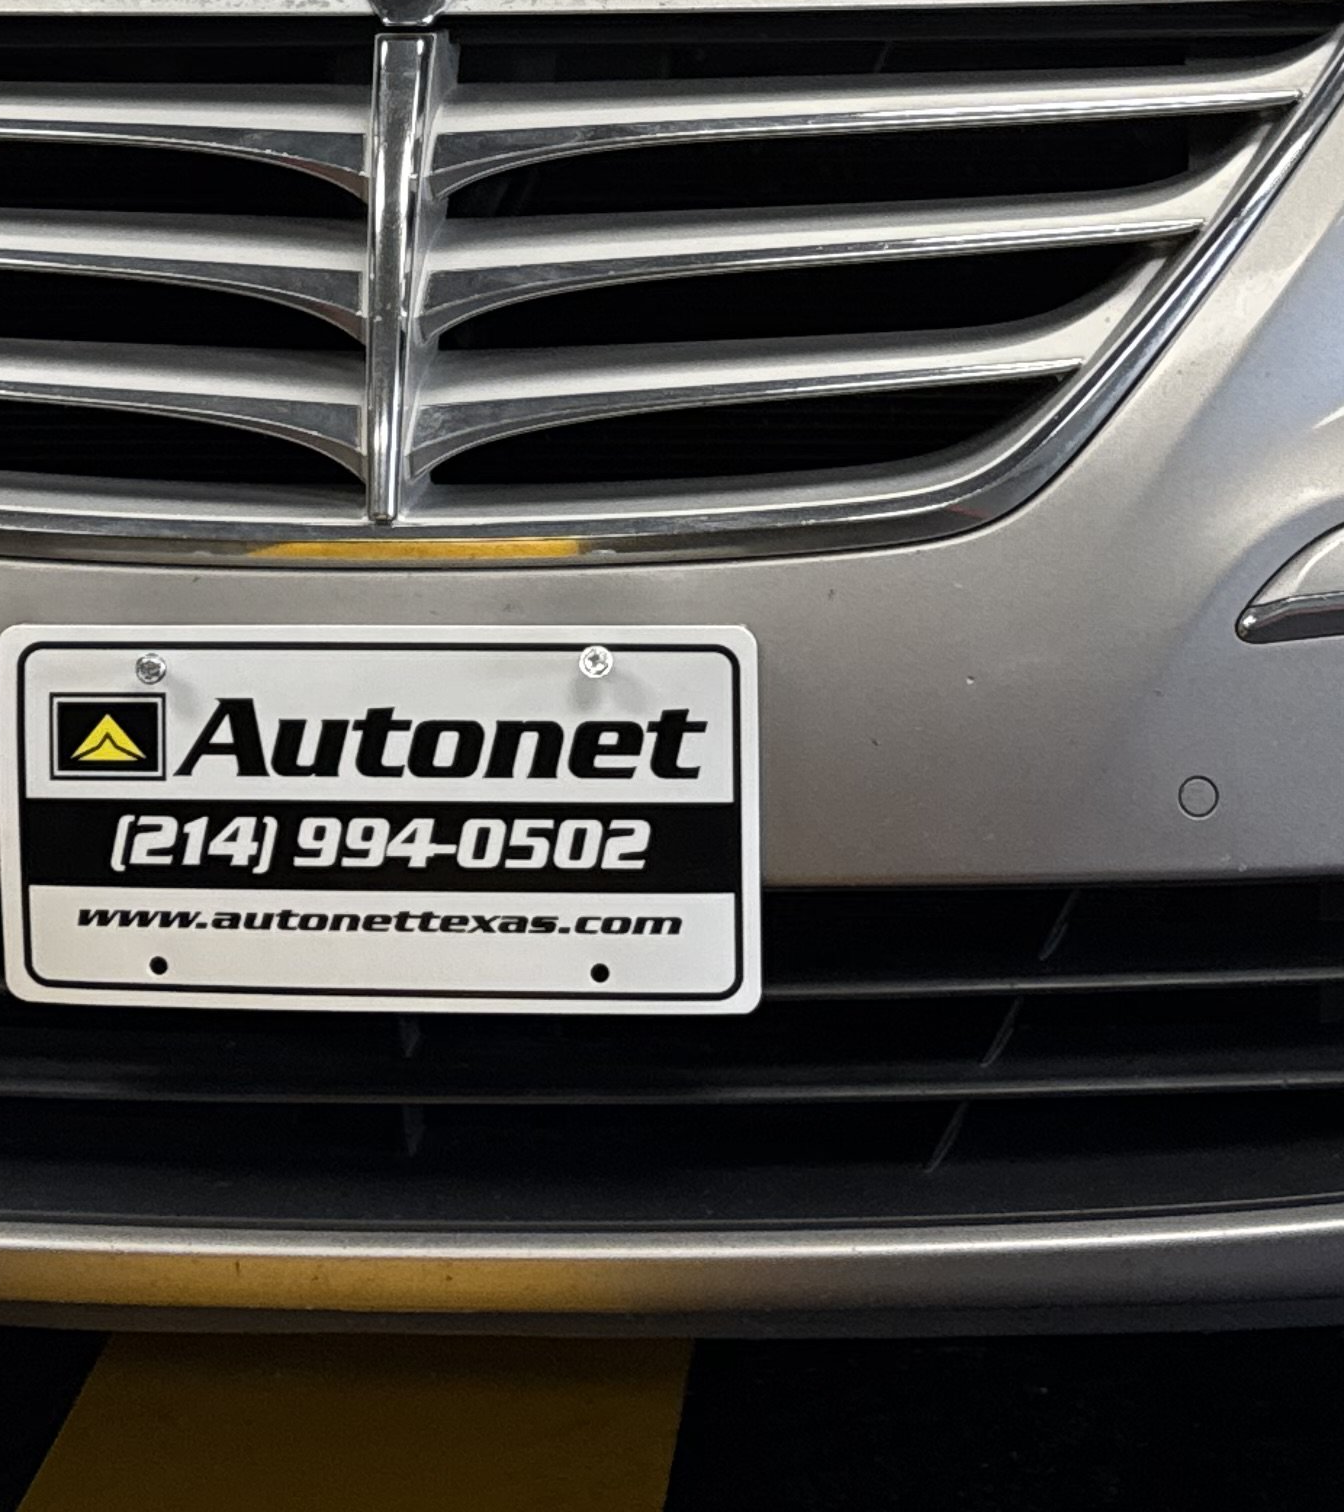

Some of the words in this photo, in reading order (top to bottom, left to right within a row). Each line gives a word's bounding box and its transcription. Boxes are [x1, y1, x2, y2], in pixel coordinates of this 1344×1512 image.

[173, 697, 708, 779] Autonet
[110, 814, 278, 874] (214)
[292, 818, 652, 870] 994-0502
[77, 908, 682, 936] www.autonettexas.com
